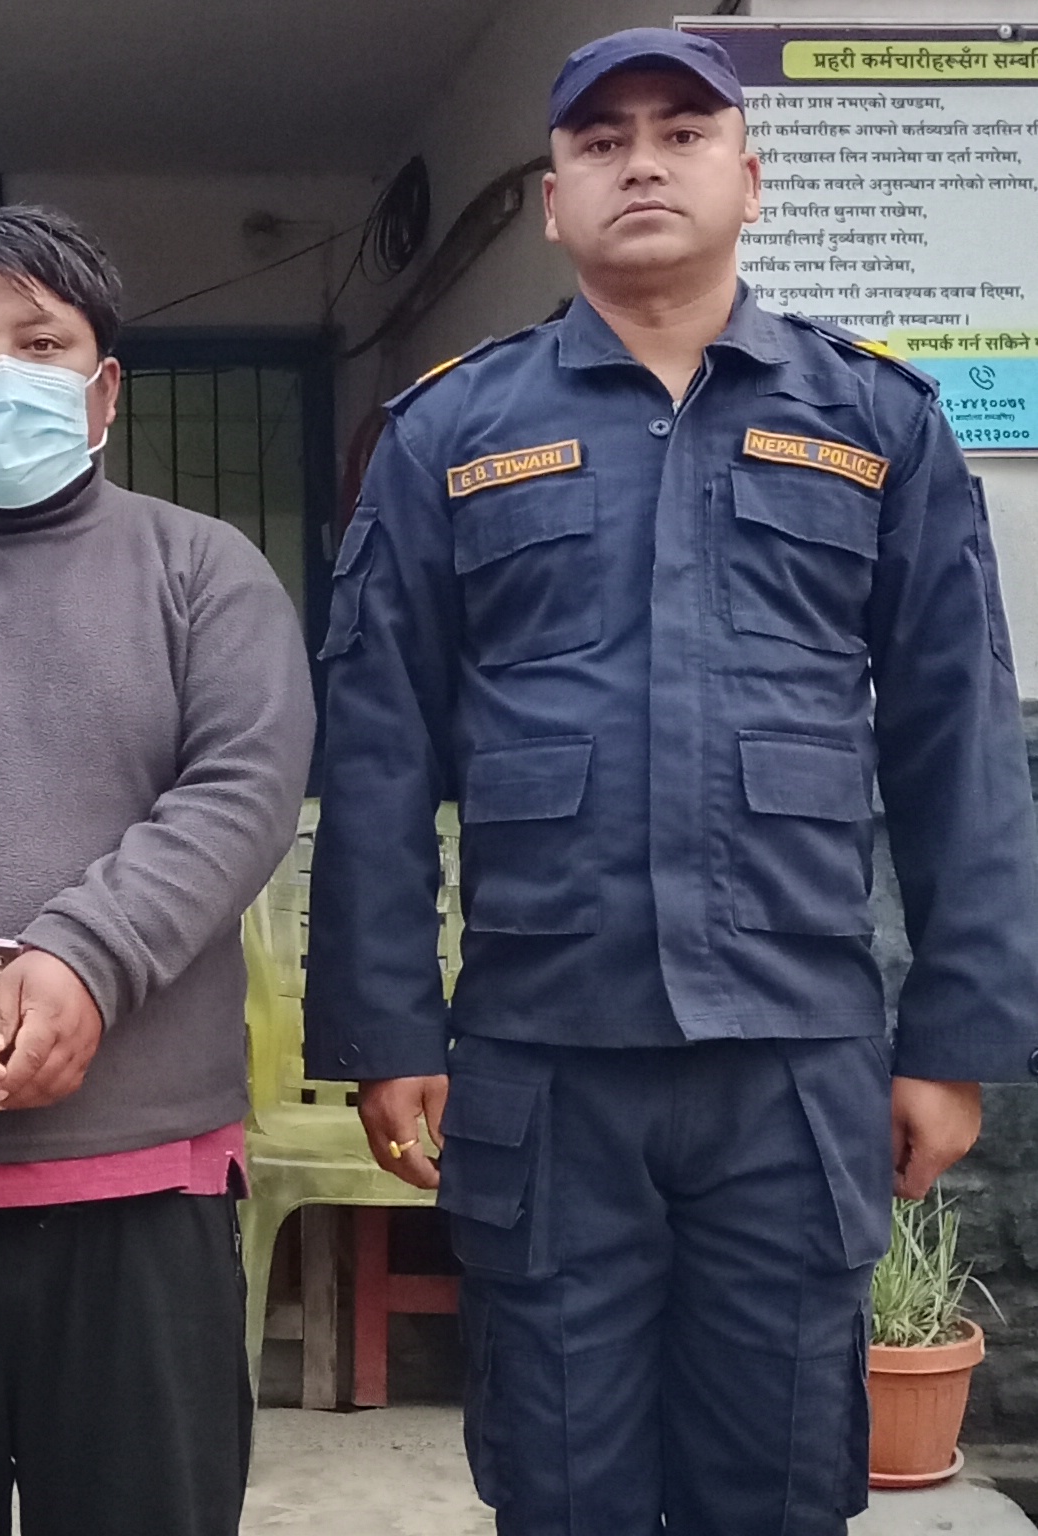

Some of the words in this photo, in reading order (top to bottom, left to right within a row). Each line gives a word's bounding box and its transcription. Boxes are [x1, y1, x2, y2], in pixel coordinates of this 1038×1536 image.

[812, 48, 855, 72] प्रहरी
[861, 46, 987, 73] कर्मचारीहरूसँग
[775, 93, 803, 109] सेवा
[837, 92, 886, 112] नभएको
[782, 150, 835, 165] दरखास्त
[839, 147, 867, 164] लिन
[926, 150, 943, 164] वा
[947, 146, 971, 165] दर्ता
[975, 146, 1022, 166] नगरेमा,
[939, 173, 985, 191] नगरेको
[782, 201, 829, 218] विपरित
[879, 201, 928, 219] राखेमा,
[740, 229, 825, 247] सेवाग्राहीलाई
[890, 228, 928, 247] गरेमा,
[740, 255, 790, 273] आर्थिक
[794, 259, 824, 273] लाभ
[829, 255, 857, 272] लिन
[838, 283, 860, 299] गरी
[864, 286, 936, 301] अनावश्यक
[980, 281, 1025, 301] दिएमा,
[907, 334, 954, 352] सम्पर्क
[958, 333, 982, 351] गर्न
[985, 332, 1031, 351] सकिने
[493, 450, 563, 476] TIWARI
[749, 436, 810, 459] NEPAL
[817, 446, 882, 481] POLICE
